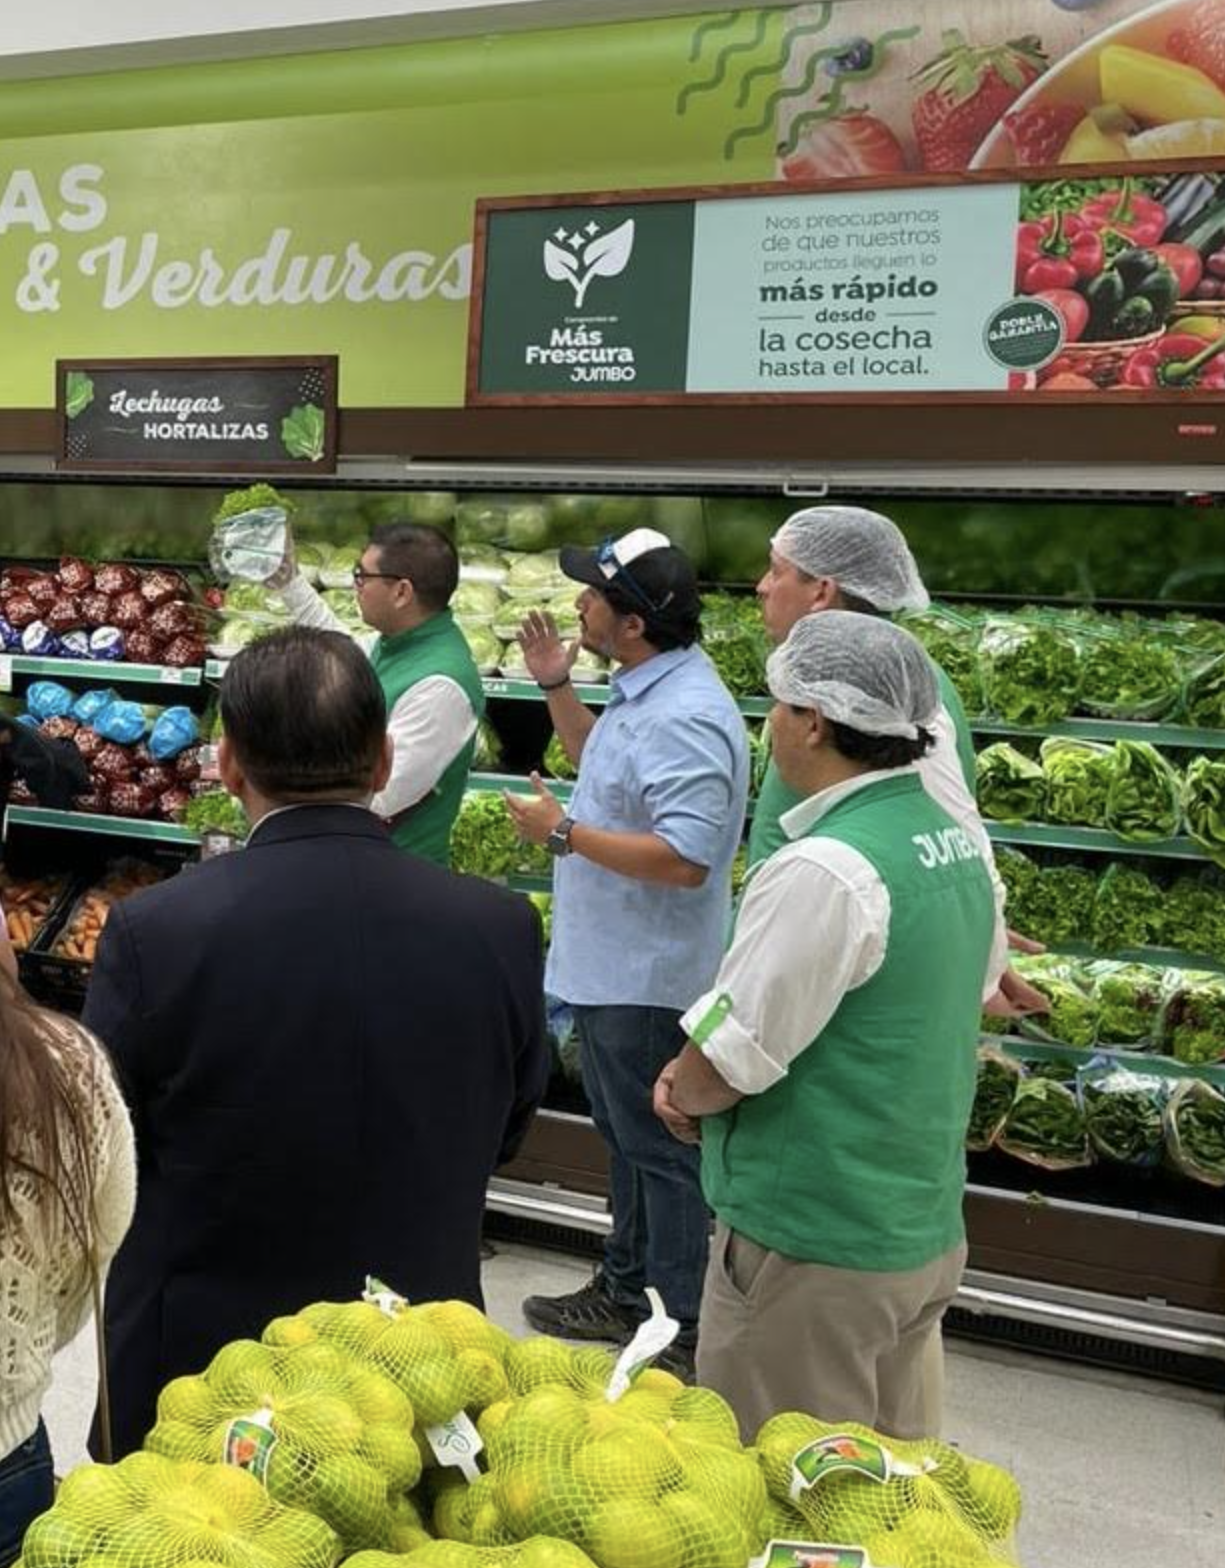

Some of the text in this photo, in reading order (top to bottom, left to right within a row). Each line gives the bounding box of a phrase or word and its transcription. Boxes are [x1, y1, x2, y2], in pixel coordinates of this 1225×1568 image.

[765, 209, 940, 230] Nos preocupamos
[762, 229, 941, 253] de que nuestros
[16, 228, 473, 312] & Verduras
[763, 252, 937, 274] productos lleguen lo
[759, 273, 938, 303] más rápido
[815, 308, 876, 323] desde
[550, 324, 603, 346] Más
[759, 325, 932, 352] la cosecha
[525, 345, 634, 364] Frescura
[570, 366, 636, 382] JUMBO
[759, 355, 929, 377] hasta el local.
[109, 389, 225, 421] Lechugas
[143, 423, 269, 440] HORTALIZAS
